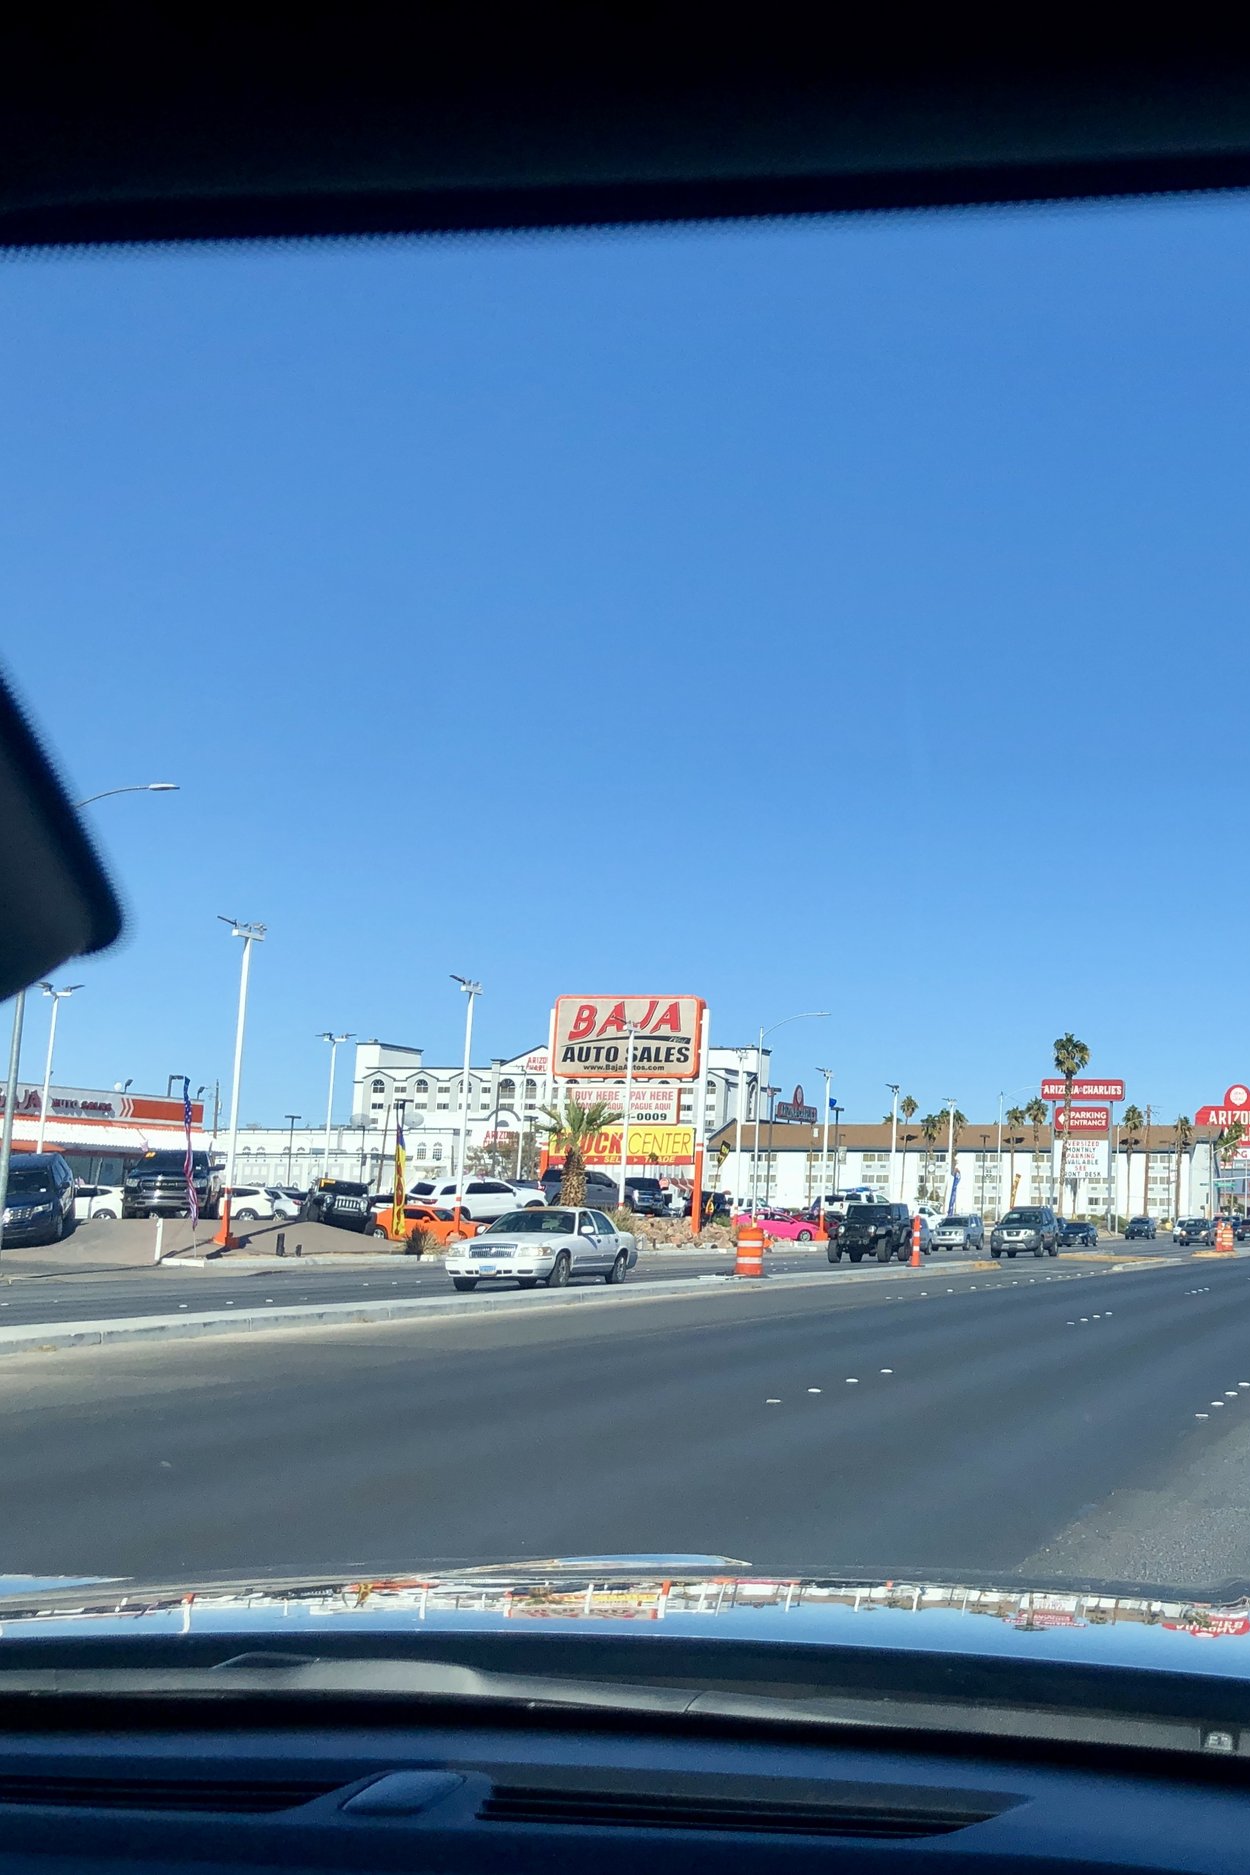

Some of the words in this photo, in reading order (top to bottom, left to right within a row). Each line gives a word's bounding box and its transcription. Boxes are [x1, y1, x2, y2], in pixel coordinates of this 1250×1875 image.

[568, 1001, 682, 1041] BAJA
[562, 1046, 619, 1063] AUTO
[626, 1046, 690, 1063] SALES
[583, 1064, 665, 1072] www.BajaAtos.com
[1083, 1085, 1122, 1095] CHARLIE'S
[575, 1091, 593, 1100] BUY
[596, 1091, 620, 1100] HERE
[630, 1091, 647, 1100] PAY
[649, 1091, 674, 1101] HERE
[630, 1103, 653, 1111] PAGUE
[1070, 1111, 1106, 1119] PARKING
[628, 1132, 691, 1155] CENTER
